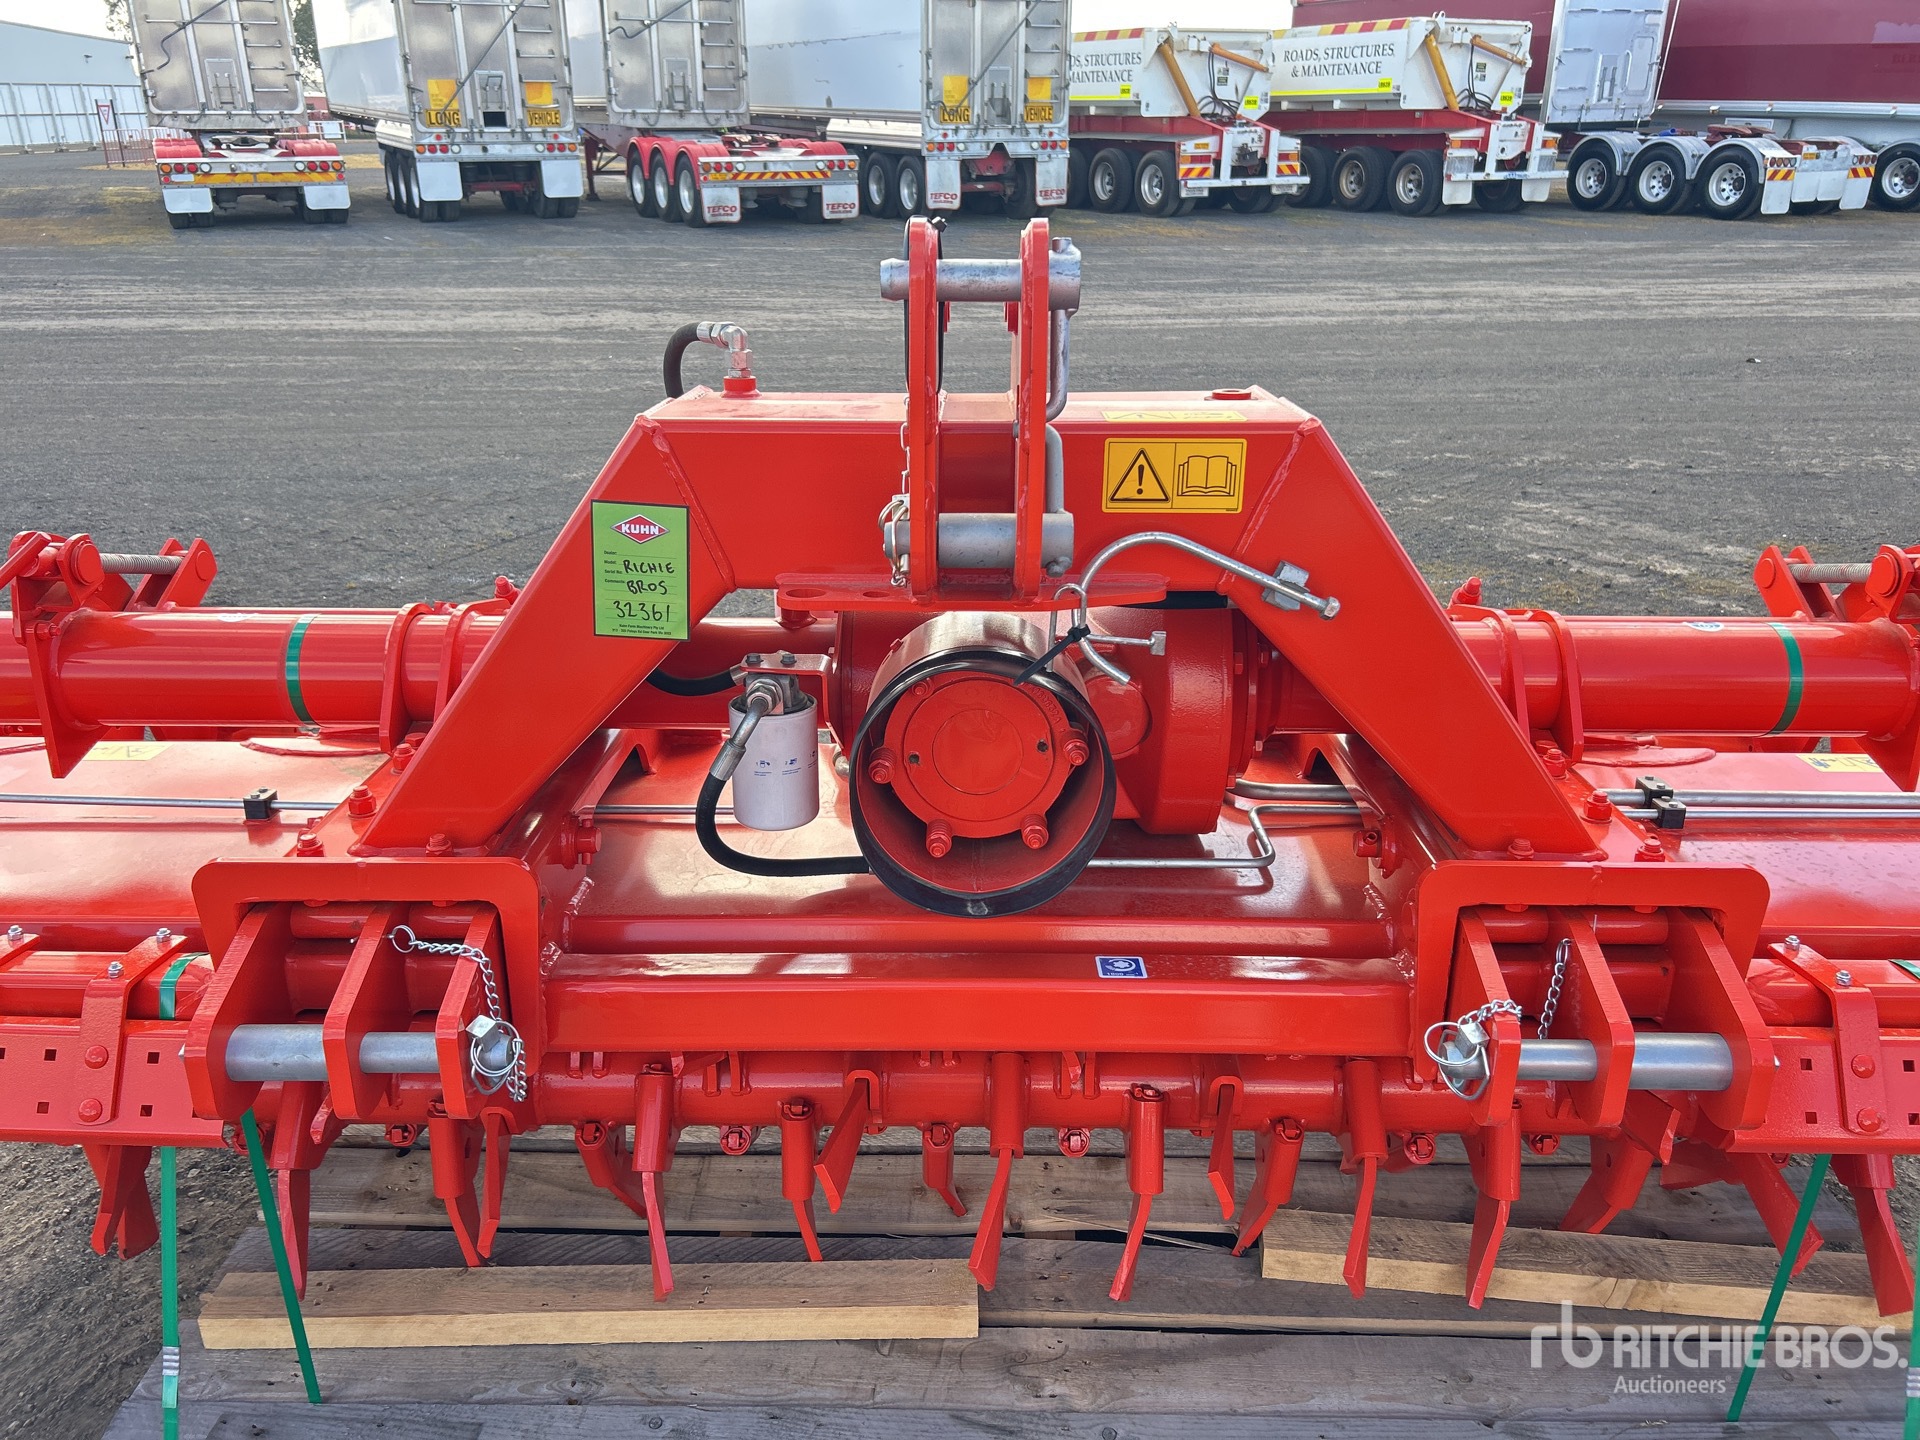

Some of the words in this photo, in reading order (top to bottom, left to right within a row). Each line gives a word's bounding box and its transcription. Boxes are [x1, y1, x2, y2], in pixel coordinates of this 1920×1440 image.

[1084, 52, 1142, 67] STRUCTURES
[1284, 48, 1320, 62] ROADS,
[1291, 65, 1299, 78] &
[1301, 61, 1382, 77] MAINTENANCE
[429, 110, 460, 125] LONG
[528, 111, 560, 125] VEHICLE
[942, 107, 970, 122] LONG
[1025, 106, 1052, 121] VEHICLE
[1039, 189, 1066, 197] TEFCO
[707, 205, 737, 213] TEFCO
[826, 203, 856, 211] TEFCO
[621, 523, 659, 534] KUHN
[623, 560, 675, 574] RICHIE
[626, 580, 667, 595] BROS
[613, 600, 670, 622] 32361
